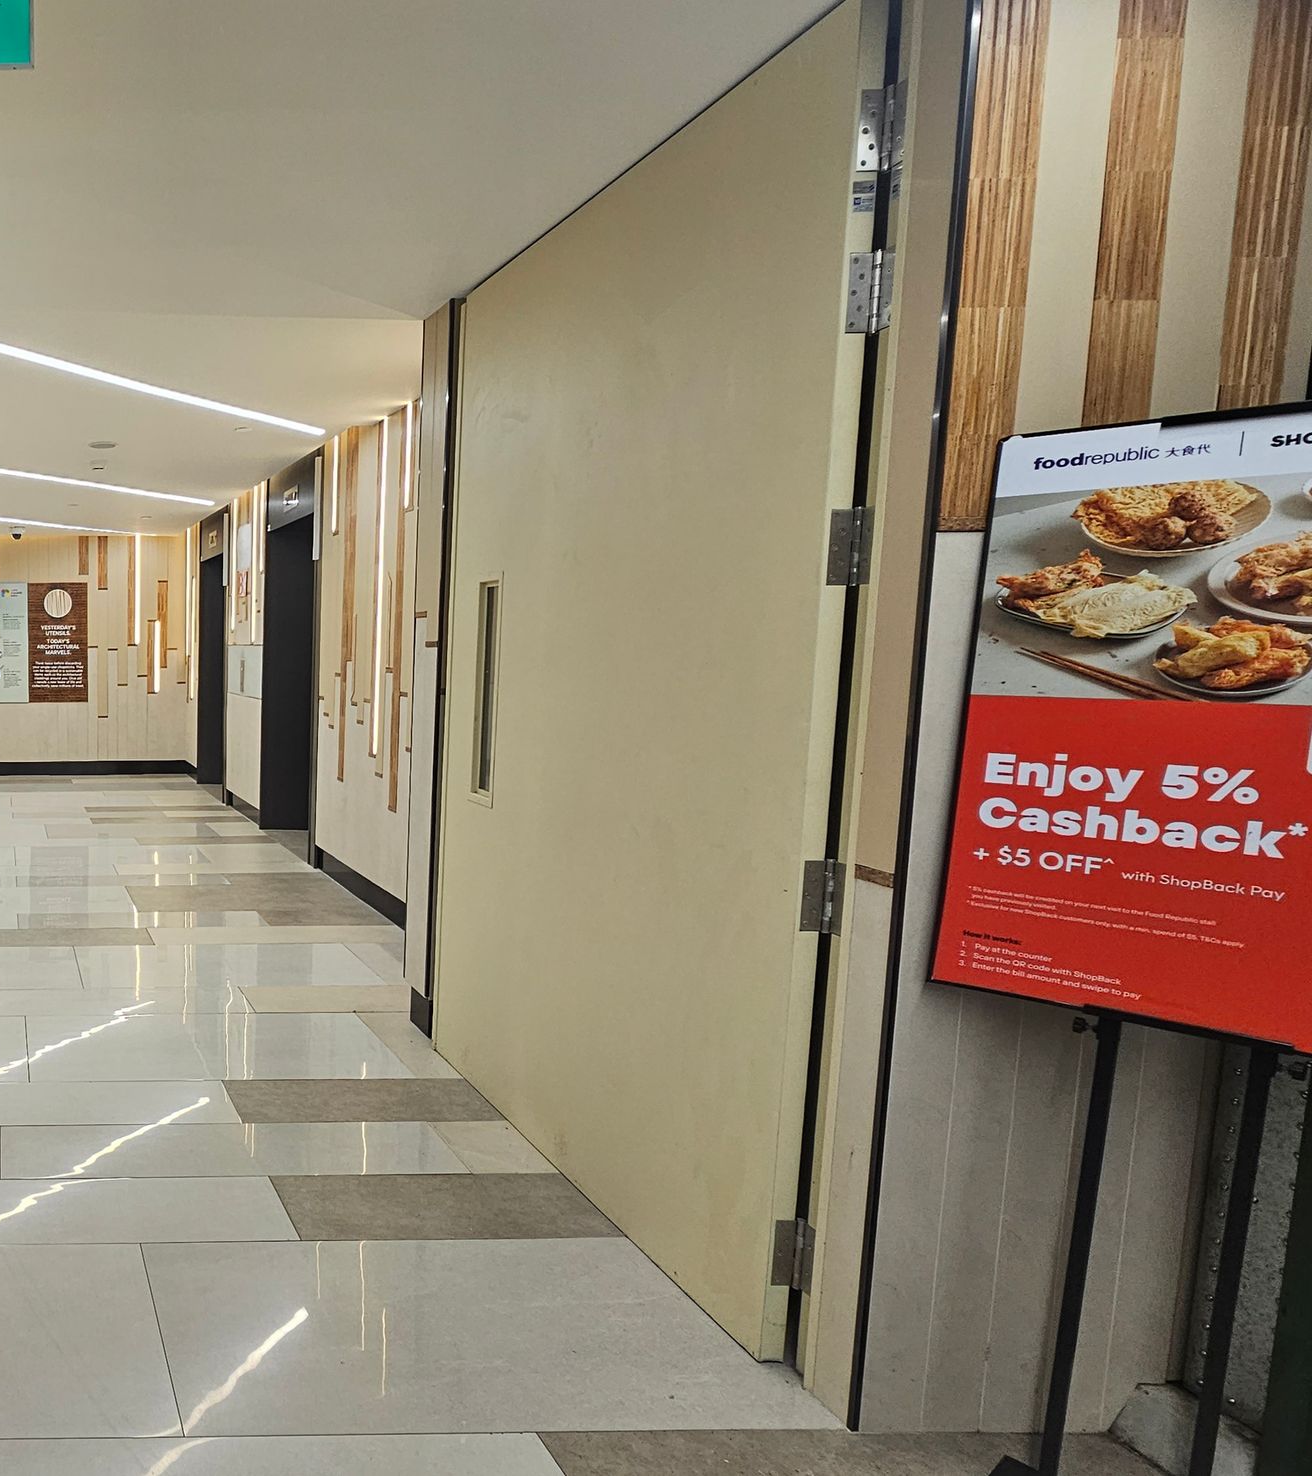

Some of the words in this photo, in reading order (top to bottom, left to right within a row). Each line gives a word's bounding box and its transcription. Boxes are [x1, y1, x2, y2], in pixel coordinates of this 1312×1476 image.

[1033, 446, 1160, 470] foodrepublic
[1165, 443, 1211, 458] 大食代
[983, 752, 1144, 802] Enjoy
[1161, 764, 1259, 805] 5%
[973, 848, 990, 861] +
[997, 845, 1031, 868] $5
[1121, 871, 1155, 884] with
[1160, 873, 1245, 895] ShopBack
[1250, 886, 1285, 901] Pay
[1024, 910, 1057, 919] ShopBack
[1165, 914, 1198, 924] Republic
[963, 929, 982, 939] How
[975, 943, 990, 953] Pay
[1017, 951, 1053, 962] counter
[972, 962, 995, 971] Enter
[1026, 973, 1061, 984] amount
[1062, 979, 1080, 988] and
[1081, 983, 1110, 994] swipe
[1123, 990, 1141, 1000] pay
[973, 952, 995, 961] Scan
[1012, 960, 1026, 968] QR
[1028, 962, 1050, 972] code
[1052, 967, 1071, 976] with
[1073, 970, 1122, 985] ShopBack
